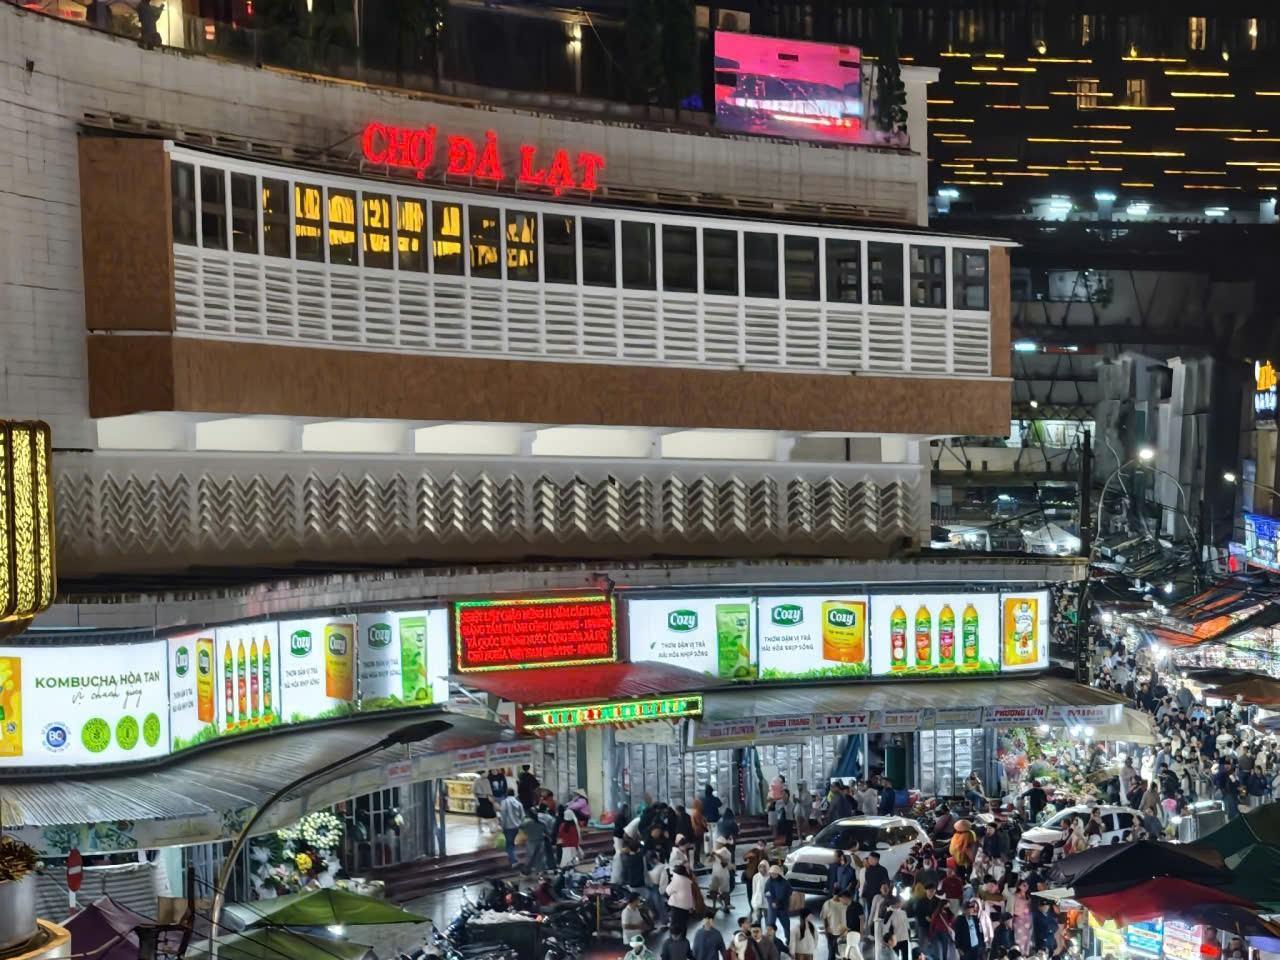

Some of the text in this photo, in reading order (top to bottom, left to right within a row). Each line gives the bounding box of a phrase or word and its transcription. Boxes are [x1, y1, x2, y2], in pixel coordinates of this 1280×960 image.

[363, 123, 604, 195] CHỢ ĐÀ LẠT
[669, 612, 698, 631] Cozy
[773, 606, 801, 626] Cozy
[829, 610, 855, 628] Cozy
[291, 634, 311, 654] Cozy
[370, 627, 392, 644] Cozy
[35, 671, 160, 689] KOMBUCHA HÒA TAN
[827, 715, 866, 725] TY TY
